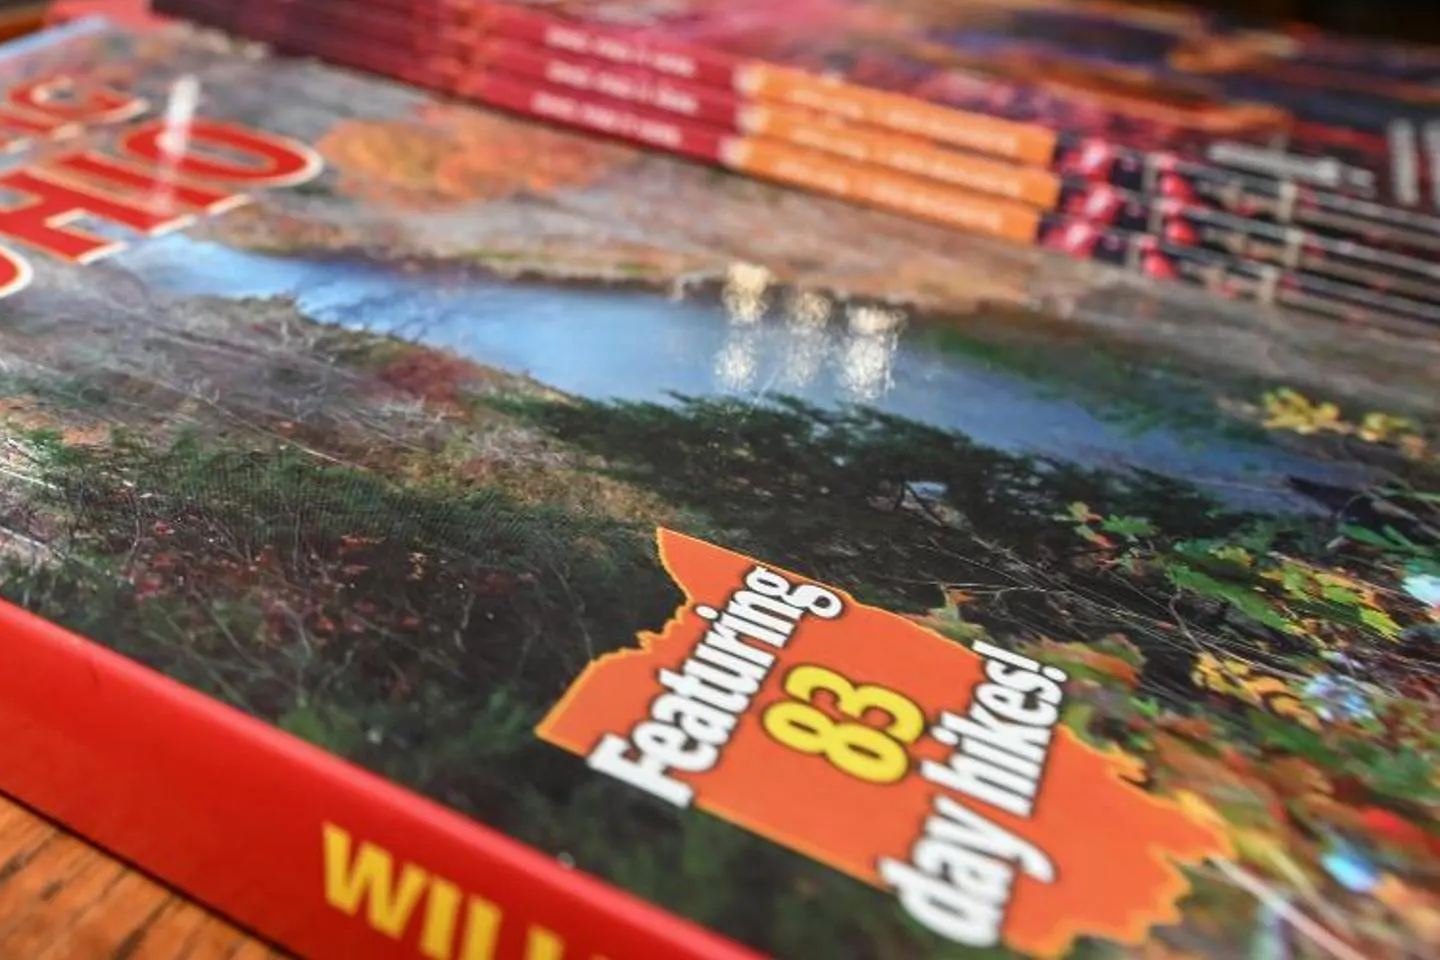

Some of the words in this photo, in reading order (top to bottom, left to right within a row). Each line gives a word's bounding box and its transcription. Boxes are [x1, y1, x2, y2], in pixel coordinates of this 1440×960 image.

[588, 565, 845, 809] Featuring
[761, 663, 926, 784] 83
[920, 640, 1069, 819] hikes!
[877, 796, 1058, 948] day
